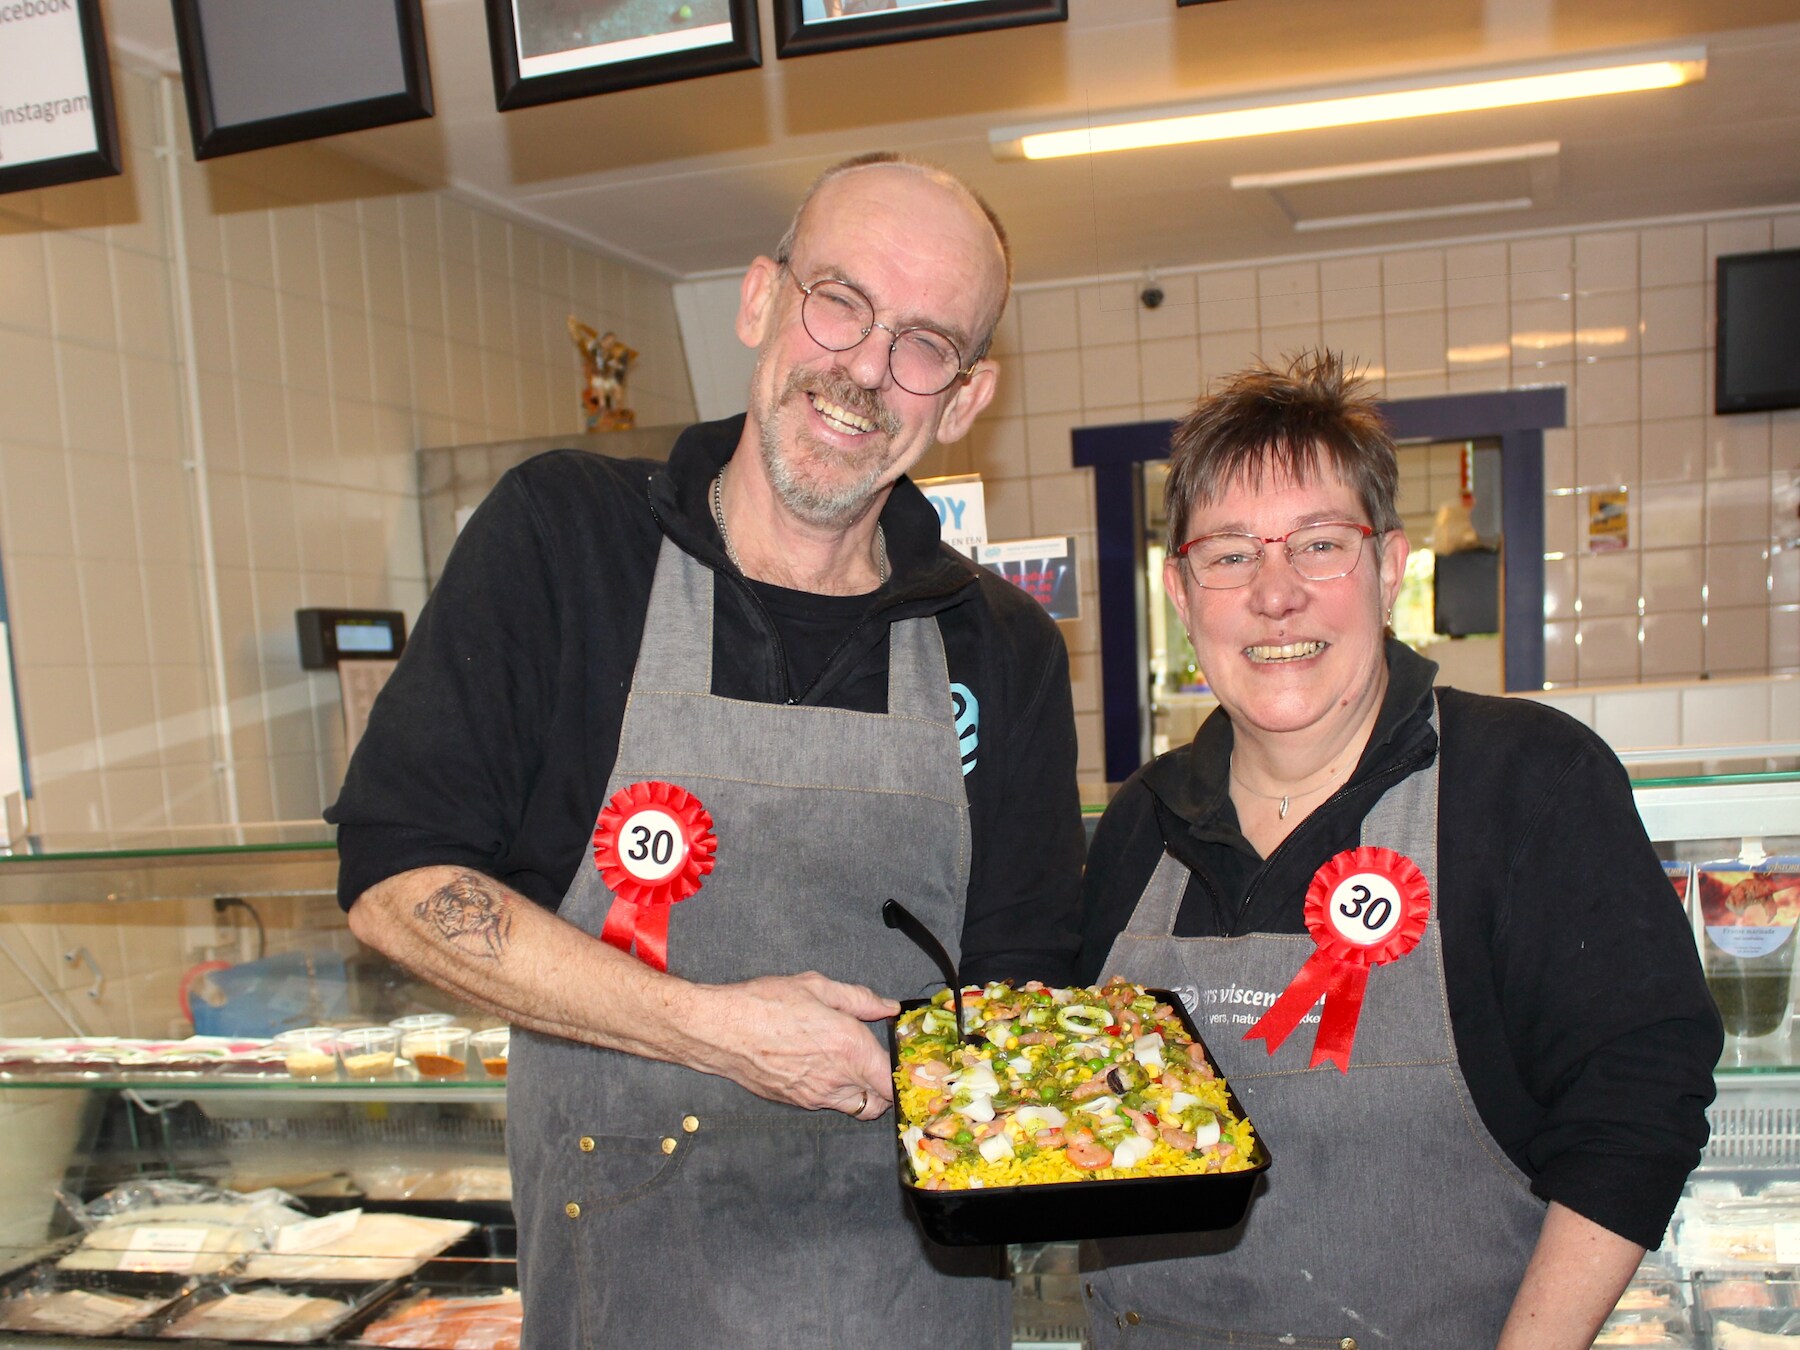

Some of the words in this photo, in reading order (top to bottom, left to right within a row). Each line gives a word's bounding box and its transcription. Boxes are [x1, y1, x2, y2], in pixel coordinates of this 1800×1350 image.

[628, 825, 674, 865] 30
[1339, 884, 1392, 930] 30
[1232, 1013, 1261, 1024] natu
